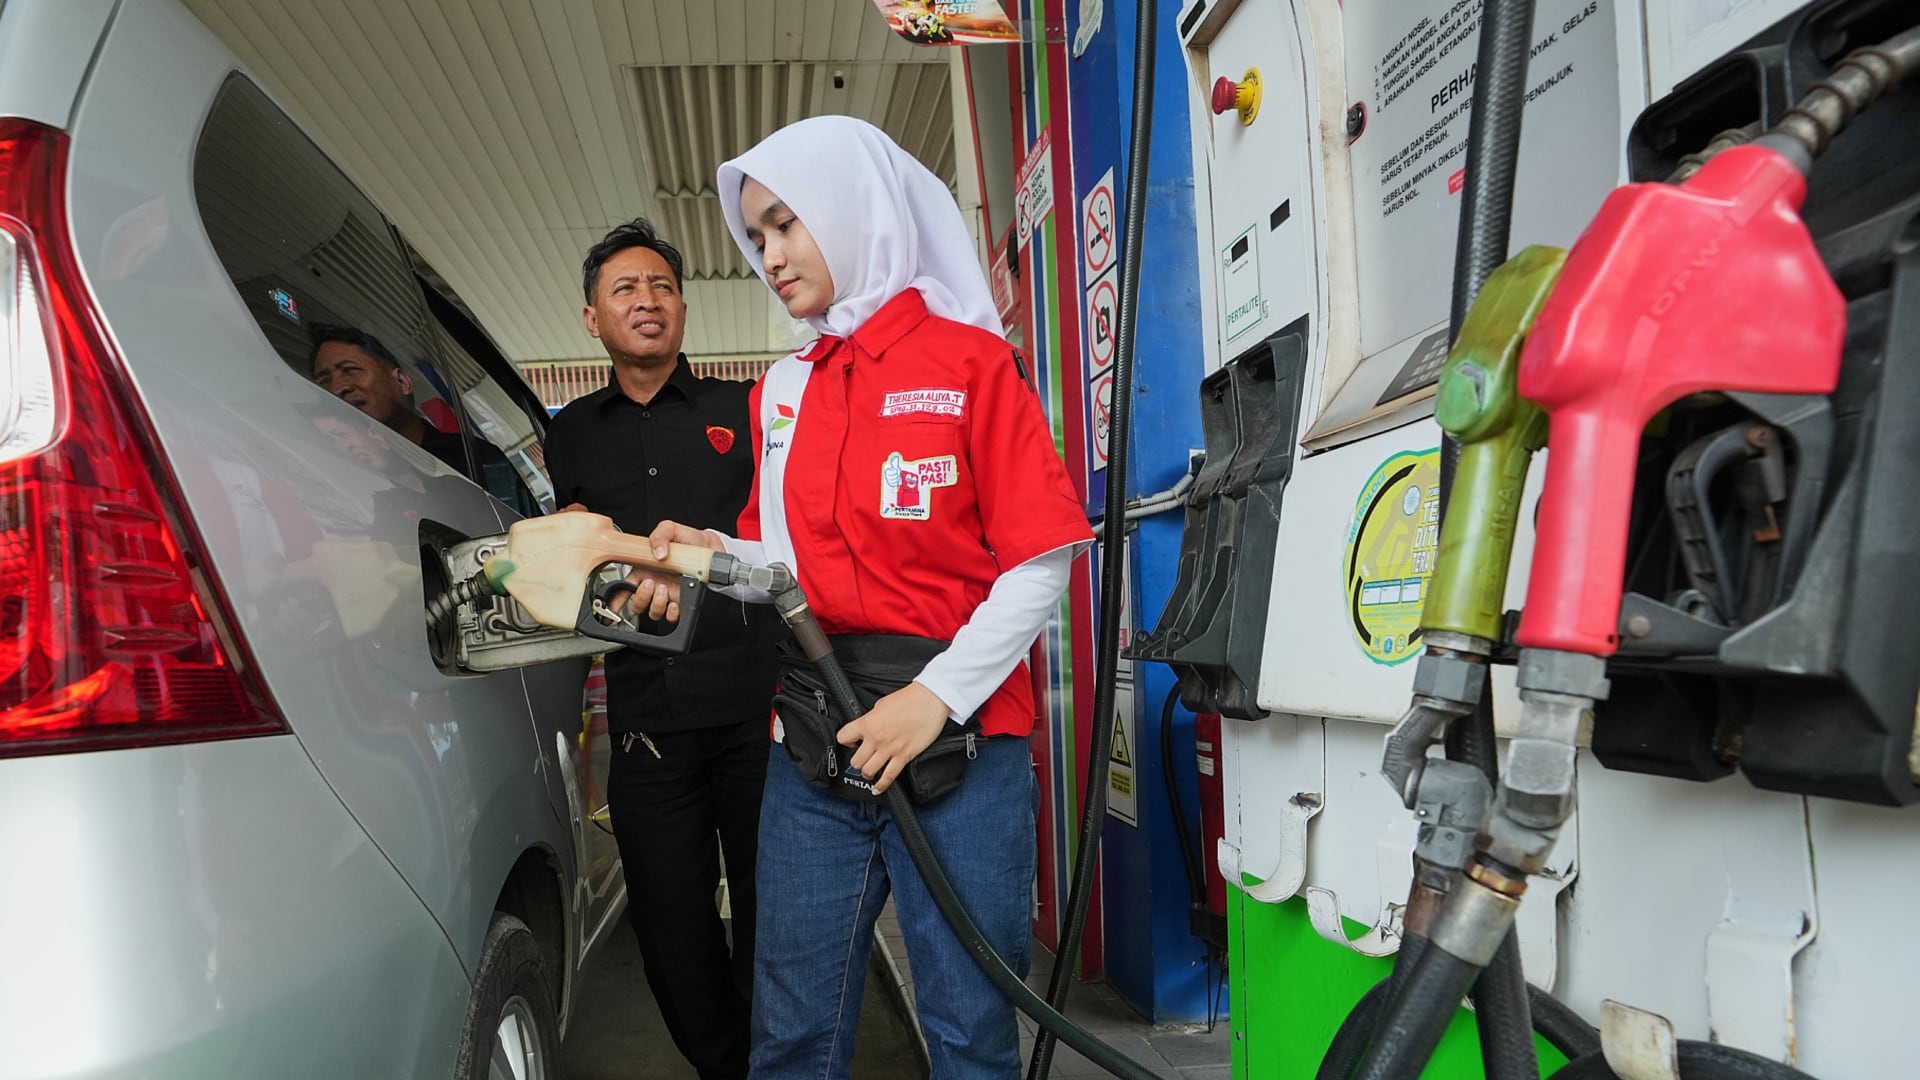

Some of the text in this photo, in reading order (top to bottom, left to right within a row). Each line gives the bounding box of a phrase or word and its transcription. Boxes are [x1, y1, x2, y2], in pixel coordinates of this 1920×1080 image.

[935, 3, 978, 15] FASTER
[1382, 49, 1410, 80] NAIKKAN
[1411, 25, 1439, 54] HANDEL
[1440, 13, 1449, 28] KE
[1450, 0, 1470, 17] POS
[1382, 37, 1407, 67] ANGKAT
[1383, 65, 1410, 93] TUNGGU
[1410, 41, 1435, 70] SAMPAI
[1436, 18, 1462, 47] ANGKA
[1463, 9, 1471, 22] DI
[1384, 75, 1414, 107] ARAHKAN
[1415, 56, 1438, 80] NOSEL
[1439, 21, 1476, 59] KETANGKI
[1380, 146, 1409, 174] SEBELUM
[1410, 134, 1424, 151] DAN
[1425, 108, 1458, 140] SESUDAH
[1562, 1, 1598, 34] GELAS
[1383, 180, 1411, 206] SEBELUM
[1412, 161, 1438, 185] MINYAK
[1522, 62, 1573, 106] PENUNJUK
[1381, 130, 1449, 186] HARUS TETAP PENUH.
[1383, 189, 1420, 218] HARUS NOL.
[1227, 295, 1259, 326] PERTALITE
[888, 392, 924, 405] THERESIA
[918, 460, 951, 475] PASTI
[920, 472, 947, 486] PAS!
[1347, 470, 1388, 544] METROLOGI
[1411, 551, 1430, 574] TERA
[843, 777, 873, 791] PERTA
